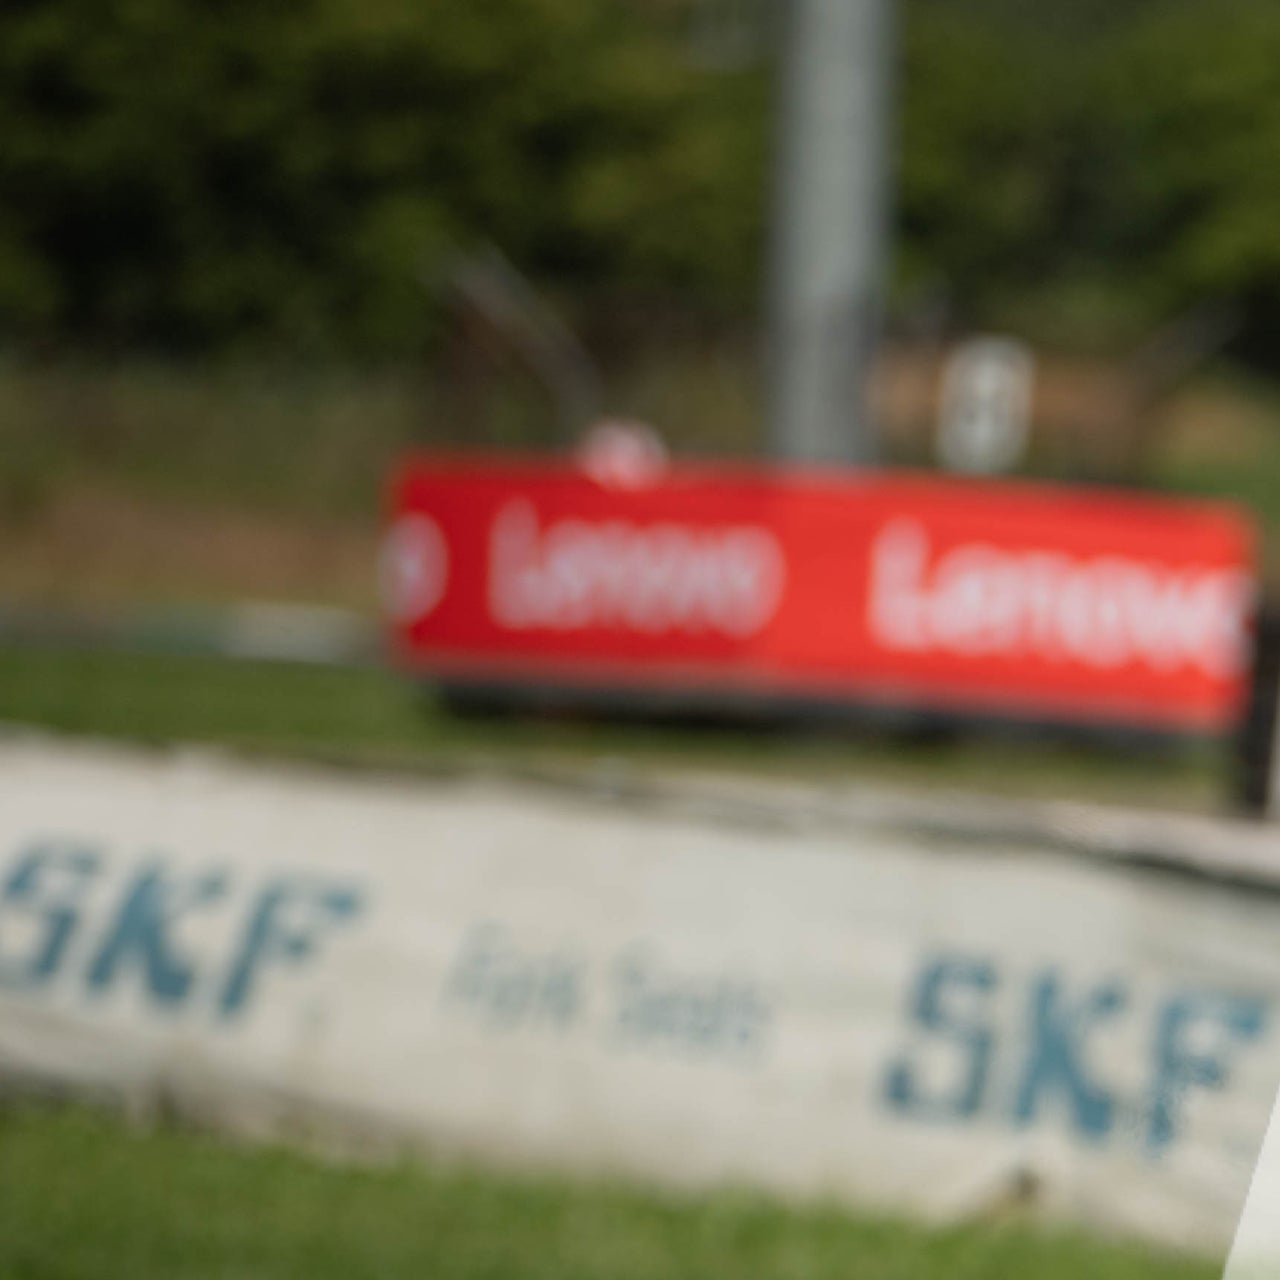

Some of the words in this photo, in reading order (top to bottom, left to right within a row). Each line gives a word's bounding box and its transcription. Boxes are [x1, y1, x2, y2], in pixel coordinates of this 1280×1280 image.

[488, 501, 786, 637] Lenovo
[0, 842, 366, 1021] SKF
[876, 950, 1270, 1155] SKF
